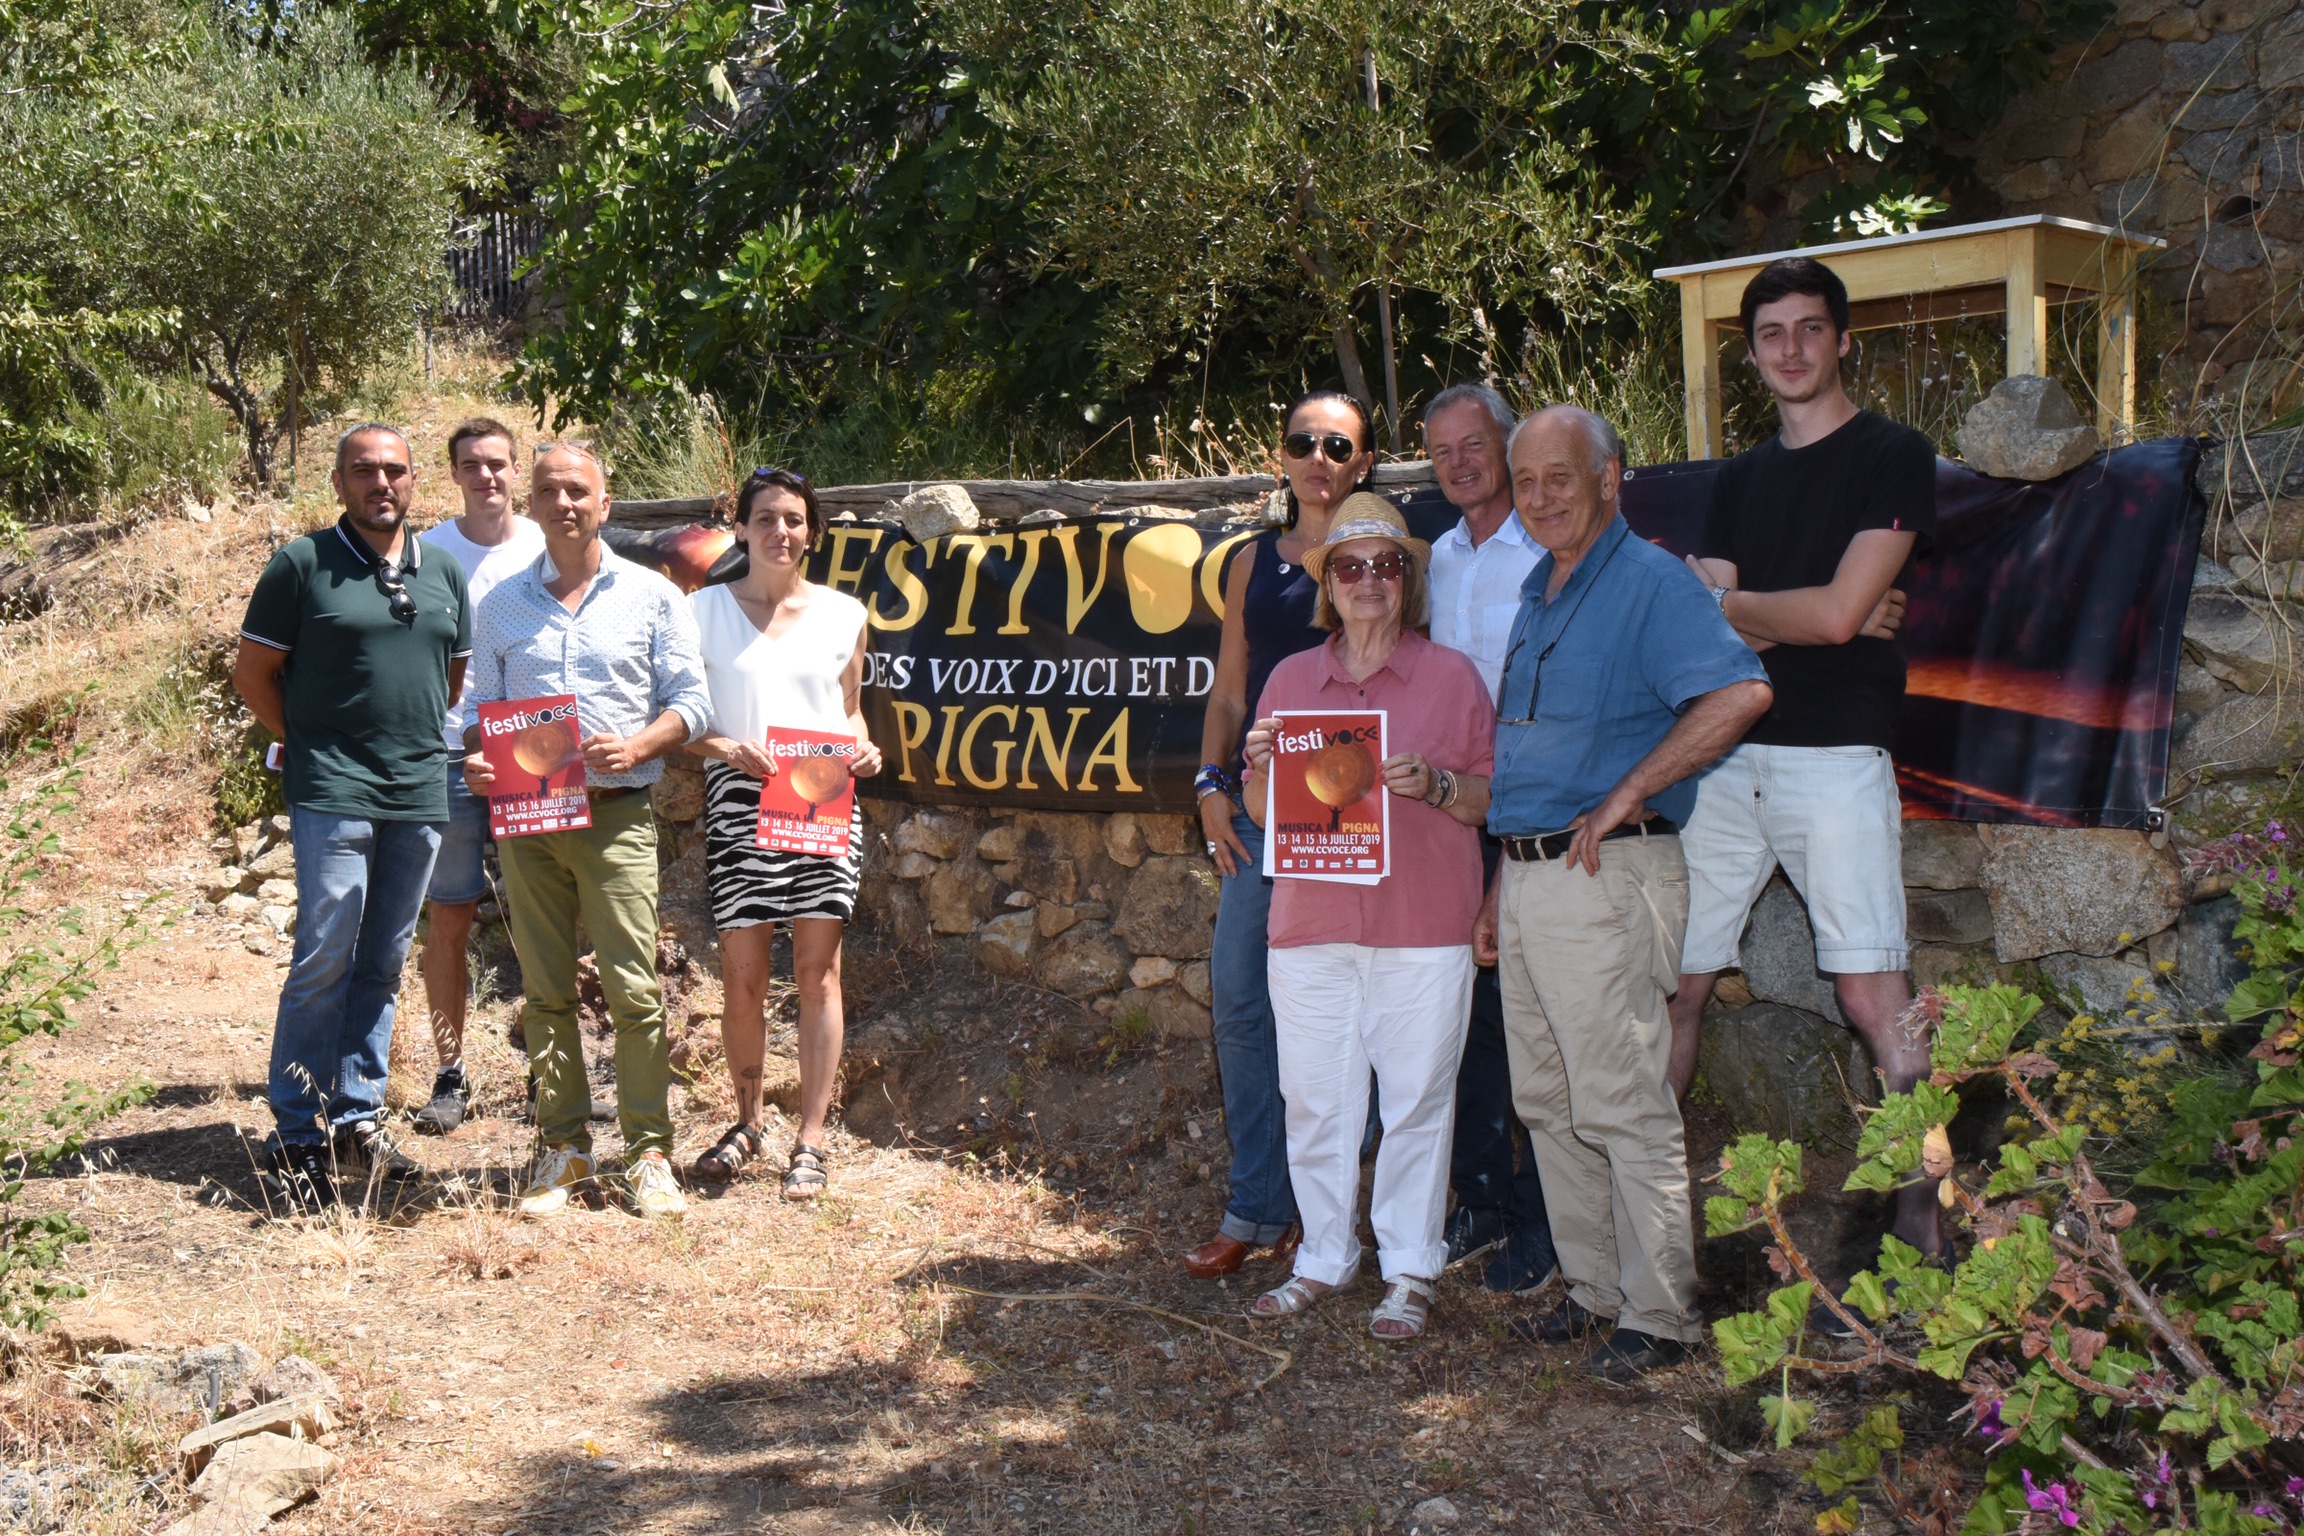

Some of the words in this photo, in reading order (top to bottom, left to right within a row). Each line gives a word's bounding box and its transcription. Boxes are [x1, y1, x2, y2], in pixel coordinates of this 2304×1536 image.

[861, 652, 915, 690] DES
[928, 658, 1022, 694] VOIX
[1026, 658, 1119, 696] D'ICI
[1128, 657, 1176, 696] ET
[891, 701, 1143, 792] PIGNA
[492, 792, 533, 804] MUSICA
[551, 786, 585, 798] PIGNA
[493, 805, 501, 815] 13
[506, 804, 514, 813] 14
[519, 802, 527, 812] 15
[530, 801, 539, 810] 16
[541, 797, 567, 809] JUILLET
[568, 795, 586, 806] 2019
[506, 807, 577, 821] WWW.CCVOCE.ORG
[761, 817, 769, 827] 13
[773, 819, 781, 828] 14
[785, 820, 792, 829] 15
[796, 822, 803, 831] 16
[805, 822, 830, 834] JUILLET
[832, 826, 848, 836] 2019
[762, 809, 800, 821] MUSICA
[817, 815, 848, 827] PIGNA
[1278, 823, 1322, 833] MUSICA
[1342, 822, 1379, 833] PIGNA
[1277, 834, 1286, 844] 13
[1291, 834, 1300, 844] 14
[1305, 834, 1314, 844] 15
[1318, 834, 1327, 844] 16
[1329, 834, 1359, 844] JUILLET
[1361, 834, 1380, 844] 2019
[1291, 846, 1369, 854] WWW.CCVOCE.ORG
